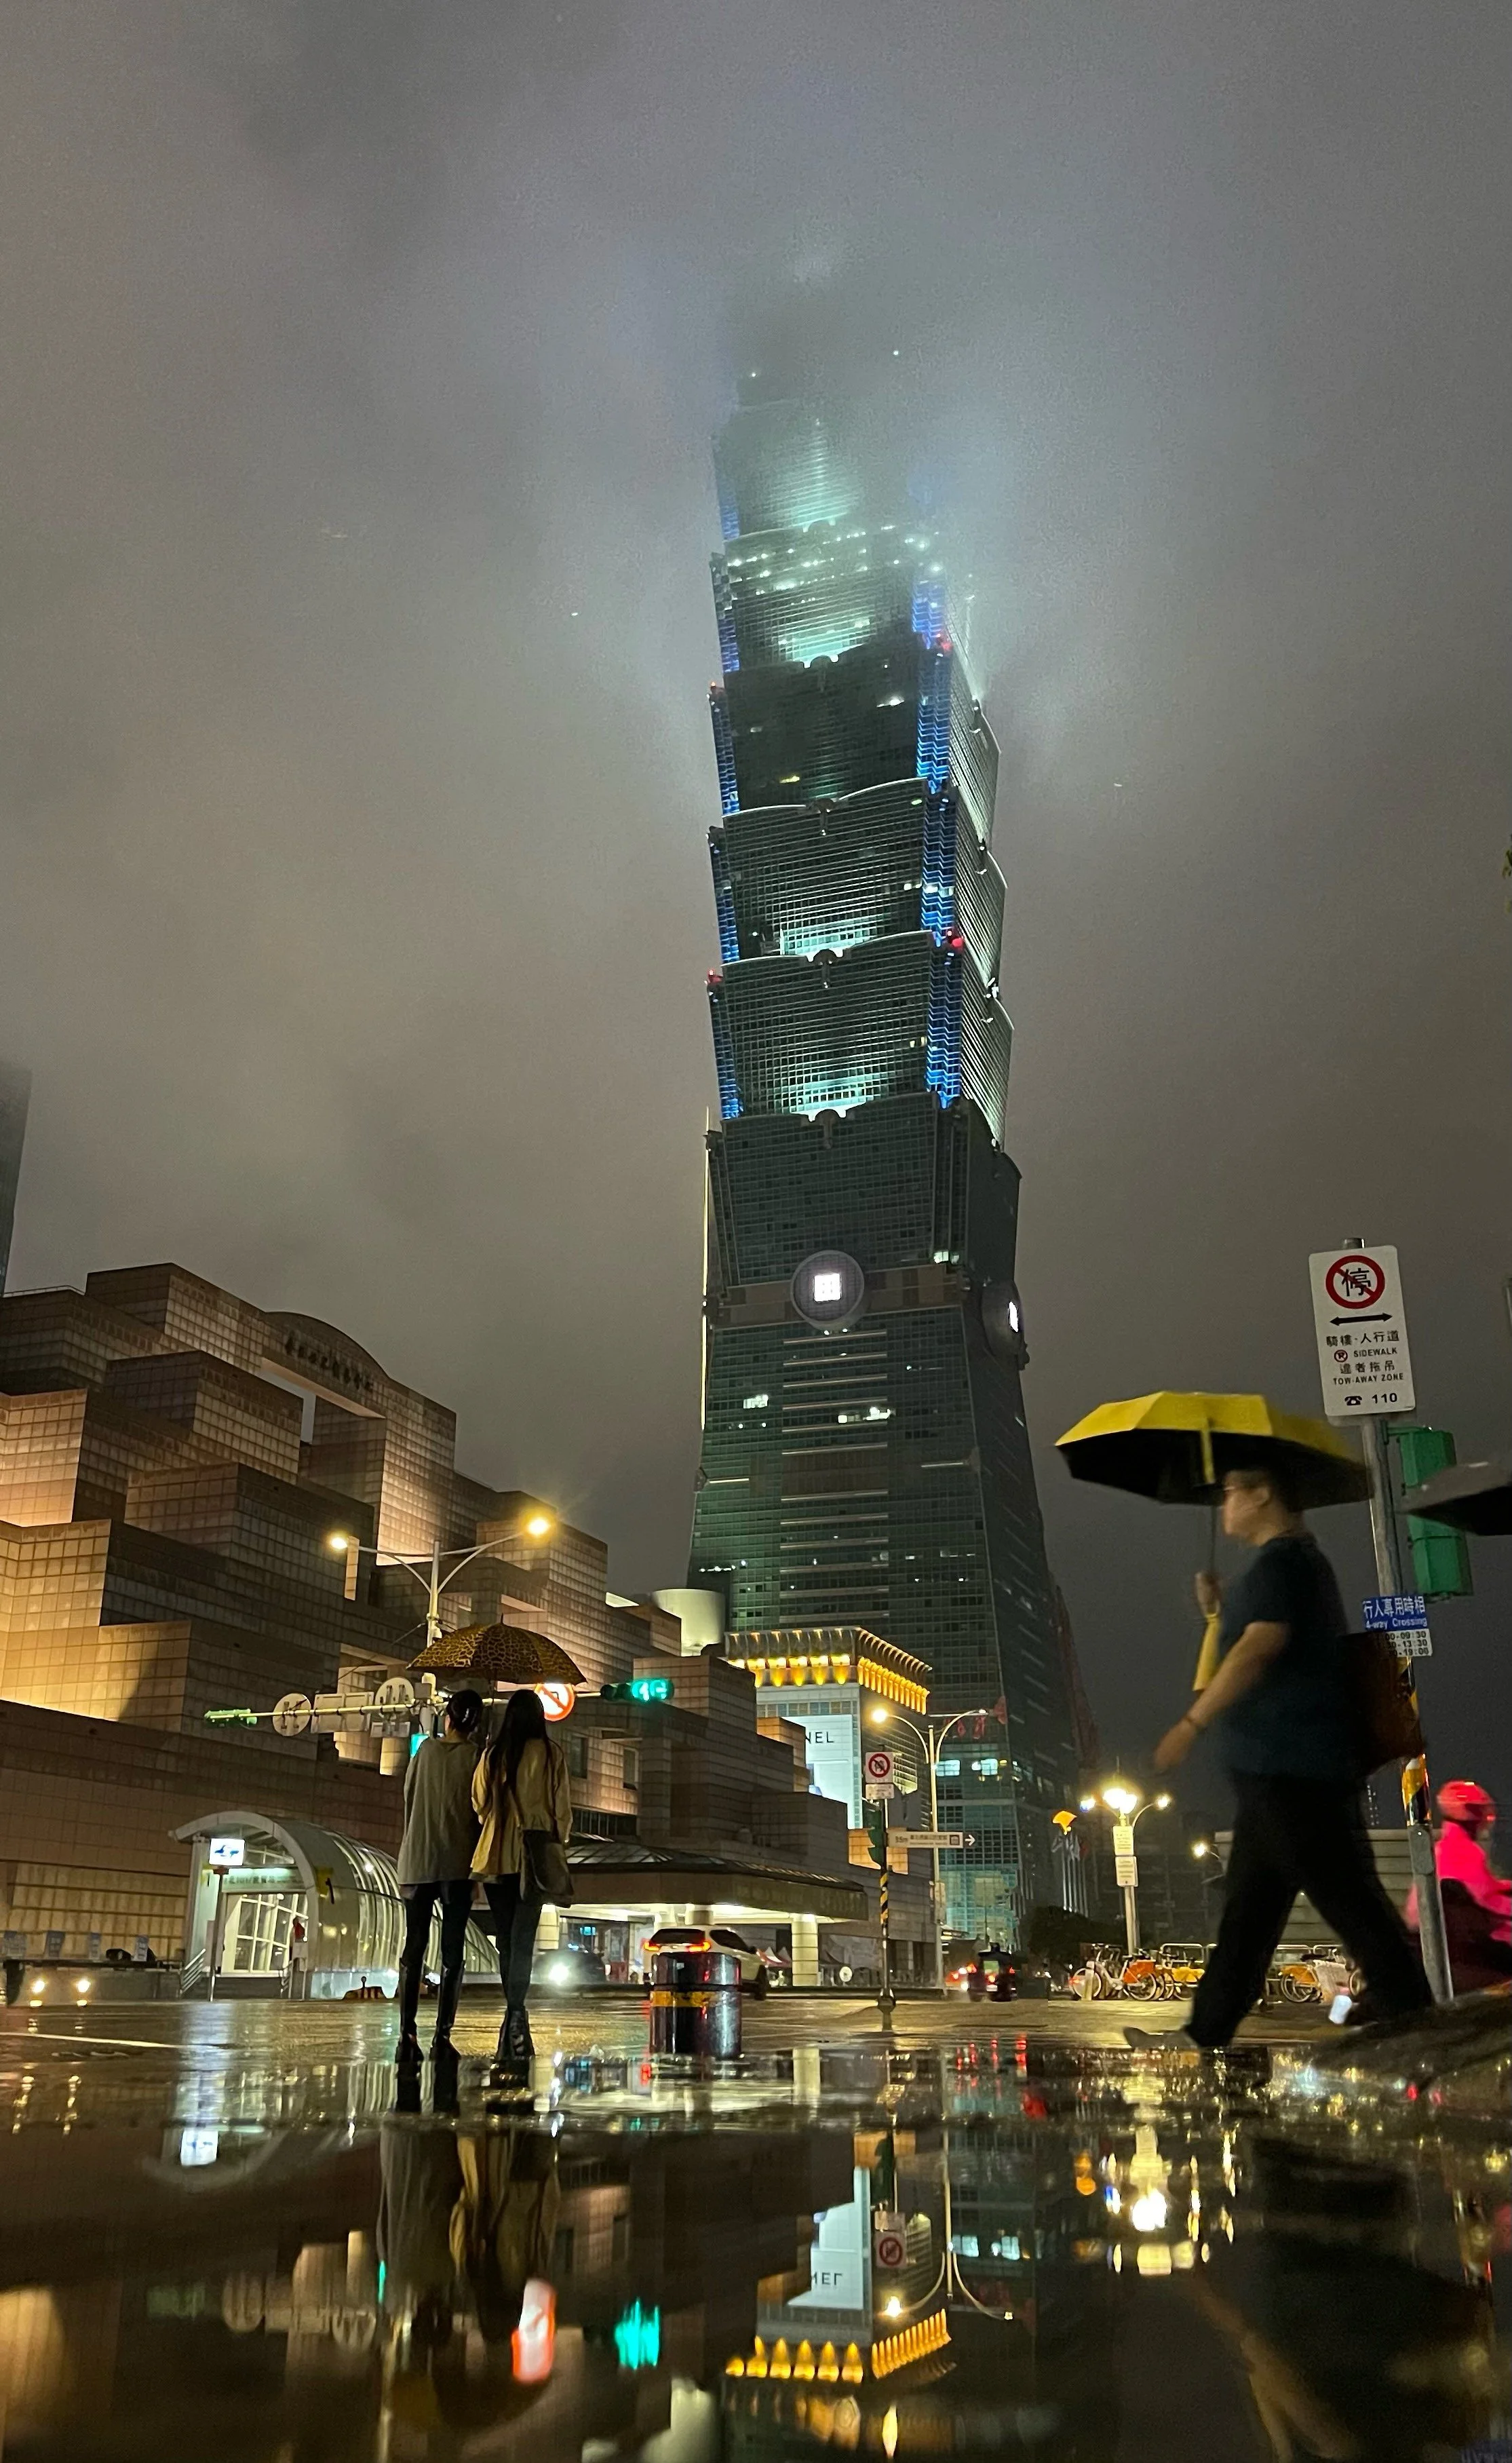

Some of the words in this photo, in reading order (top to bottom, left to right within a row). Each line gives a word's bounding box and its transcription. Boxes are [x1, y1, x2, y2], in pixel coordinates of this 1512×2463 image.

[1341, 1267, 1372, 1297] 停
[1353, 1348, 1397, 1357] SIDEWALK
[1333, 1375, 1378, 1385] TOW-AWAY
[1381, 1373, 1403, 1381] ZONE
[1372, 1392, 1397, 1404] 110
[1392, 1618, 1428, 1627] Crossing
